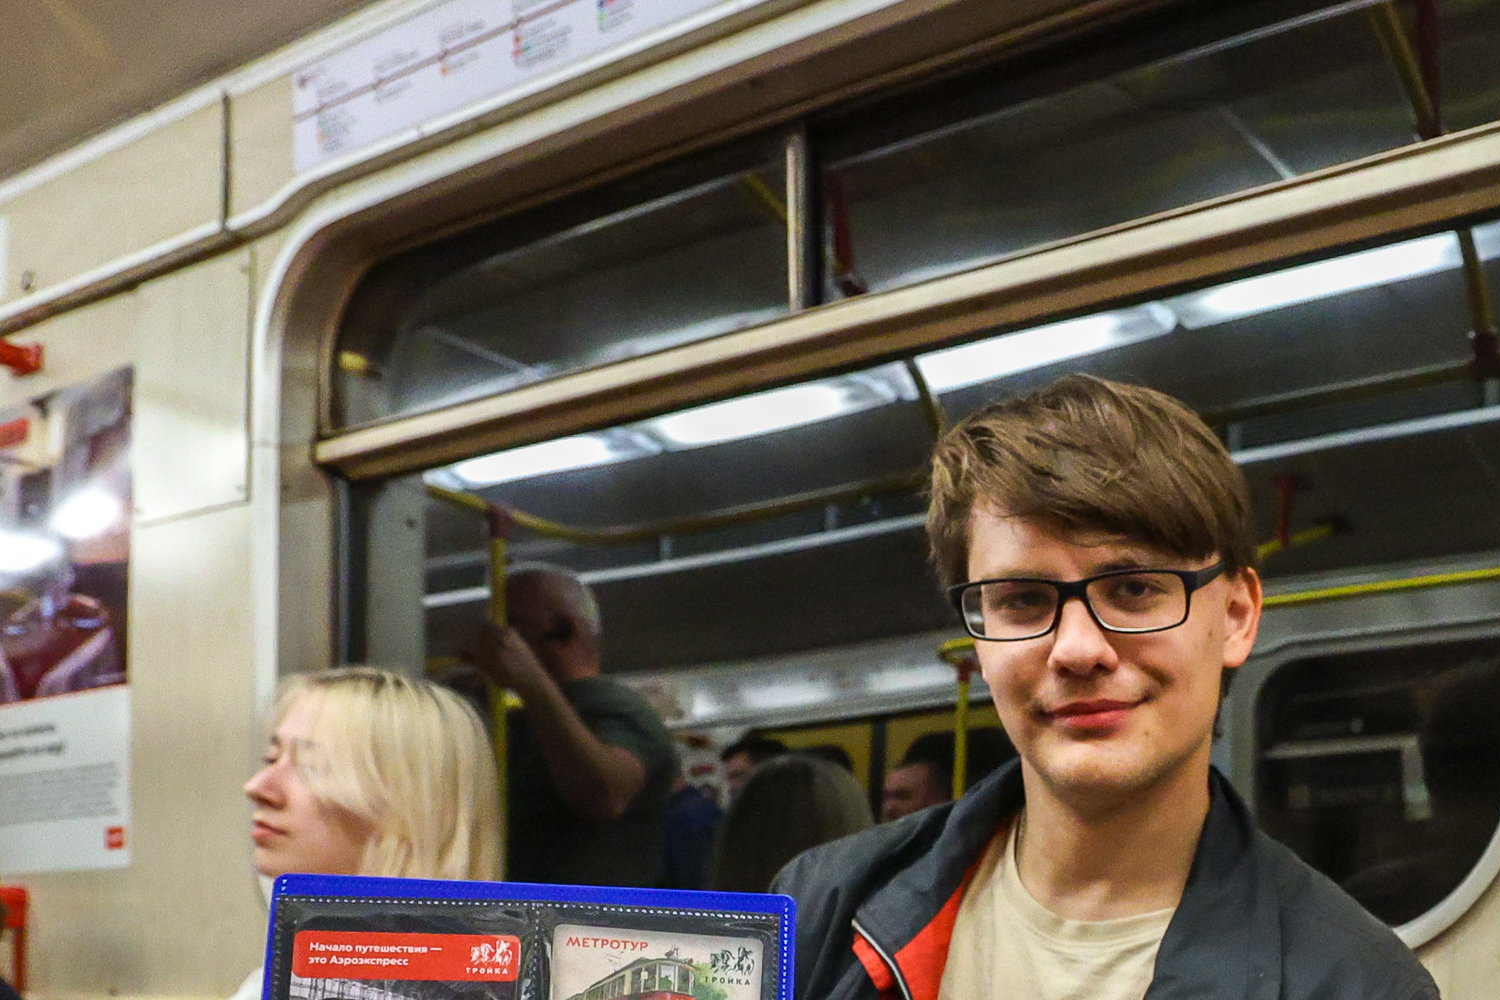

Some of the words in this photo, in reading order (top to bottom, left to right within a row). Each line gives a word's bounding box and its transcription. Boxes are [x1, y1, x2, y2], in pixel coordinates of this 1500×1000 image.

[309, 941, 353, 953] Начало
[355, 943, 428, 955] путешествия
[566, 936, 649, 951] МЕТРОТУР
[308, 956, 327, 965] это
[329, 955, 409, 967] Аэроэкспресс
[466, 966, 509, 975] ТРОЙКА
[704, 975, 751, 986] ТРОЙКА
